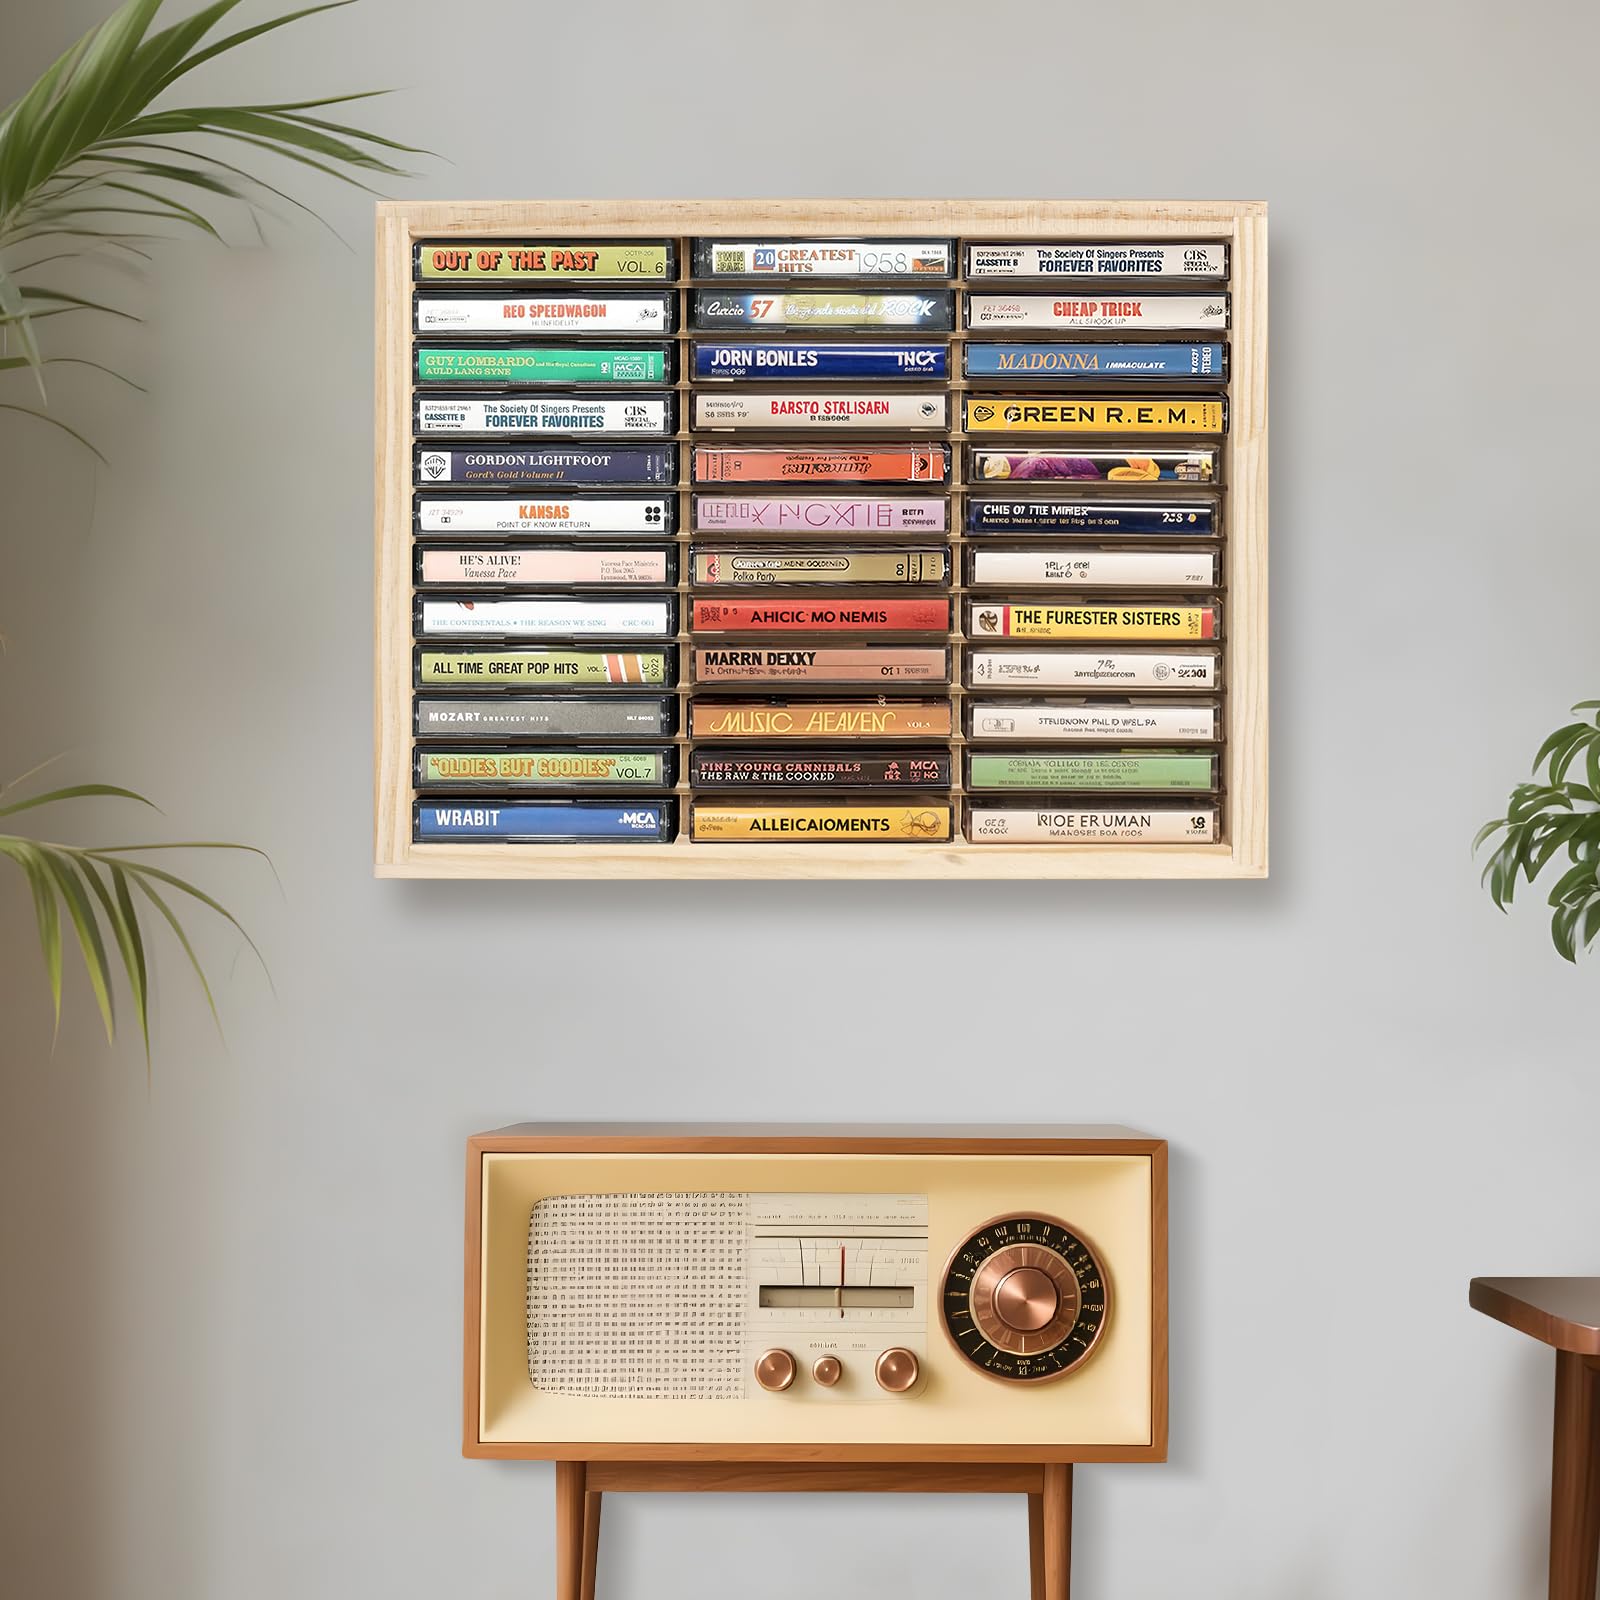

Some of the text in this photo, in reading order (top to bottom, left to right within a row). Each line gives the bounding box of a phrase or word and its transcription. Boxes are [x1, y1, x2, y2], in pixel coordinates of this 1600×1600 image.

[716, 251, 745, 261] TWIN
[756, 252, 774, 265] 20
[778, 249, 855, 261] GREATEST
[1037, 250, 1164, 260] The Society Of Singers Presents
[1184, 249, 1207, 260] CBS
[432, 251, 598, 271] OUT OF THE PAST
[617, 261, 663, 273] VOL. 6
[855, 253, 907, 273] 1958
[976, 259, 1018, 267] CASSETTE B
[1039, 260, 1162, 273] FOREVER FAVORITES
[779, 263, 813, 272] HITS
[503, 304, 607, 318] REO SPEEDWAGON
[707, 301, 744, 316] Curcio
[749, 300, 773, 319] 57
[879, 300, 936, 317] ROCK
[1053, 302, 1142, 317] CHEAP TRICK
[425, 356, 455, 366] GUY
[458, 356, 535, 367] LOMBARDO
[711, 350, 818, 367] JORN BONLES
[997, 353, 1099, 369] MADONNA
[1201, 347, 1211, 374] STEREO
[426, 367, 511, 375] AULD LANG SYNE
[483, 405, 605, 415] The Society Of Singers Presents
[624, 406, 647, 415] CBS
[771, 401, 819, 414] BARSTO
[424, 413, 466, 421] CASSETTE B
[486, 415, 604, 427] FOREVER FAVORITES
[1004, 407, 1196, 424] GREEN R.E.M.
[465, 456, 611, 466] GORDON LIGHTFOOT
[465, 471, 495, 479] Gord's
[519, 505, 569, 519] KANSAS
[459, 556, 521, 565] HE'S ALIVE!
[464, 568, 517, 578] Vanessa Pace
[757, 572, 776, 581] Party
[840, 611, 887, 623] NEMIS
[1015, 611, 1042, 624] THE
[1046, 611, 1118, 625] FURESTER
[1122, 612, 1181, 625] SISTERS
[705, 653, 762, 665] MARRN
[433, 663, 453, 674] ALL
[457, 663, 483, 674] TIME
[488, 663, 522, 674] GREAT
[527, 663, 550, 674] POP
[554, 663, 578, 674] HITS
[642, 663, 649, 674] TC
[651, 658, 659, 677] 5022
[429, 713, 480, 721] MOZART
[710, 712, 896, 733] MUSIC HEAVEN
[500, 758, 534, 777] BUT
[701, 763, 861, 772] FINE YOUNG CANNIBALS
[910, 761, 939, 769] MCA
[616, 768, 651, 778] VOL.7
[701, 772, 834, 781] THE RAW & THE COOKED
[435, 810, 499, 826] WRABIT
[623, 813, 656, 823] MCA
[750, 819, 890, 831] ALLEICAIOMENTS
